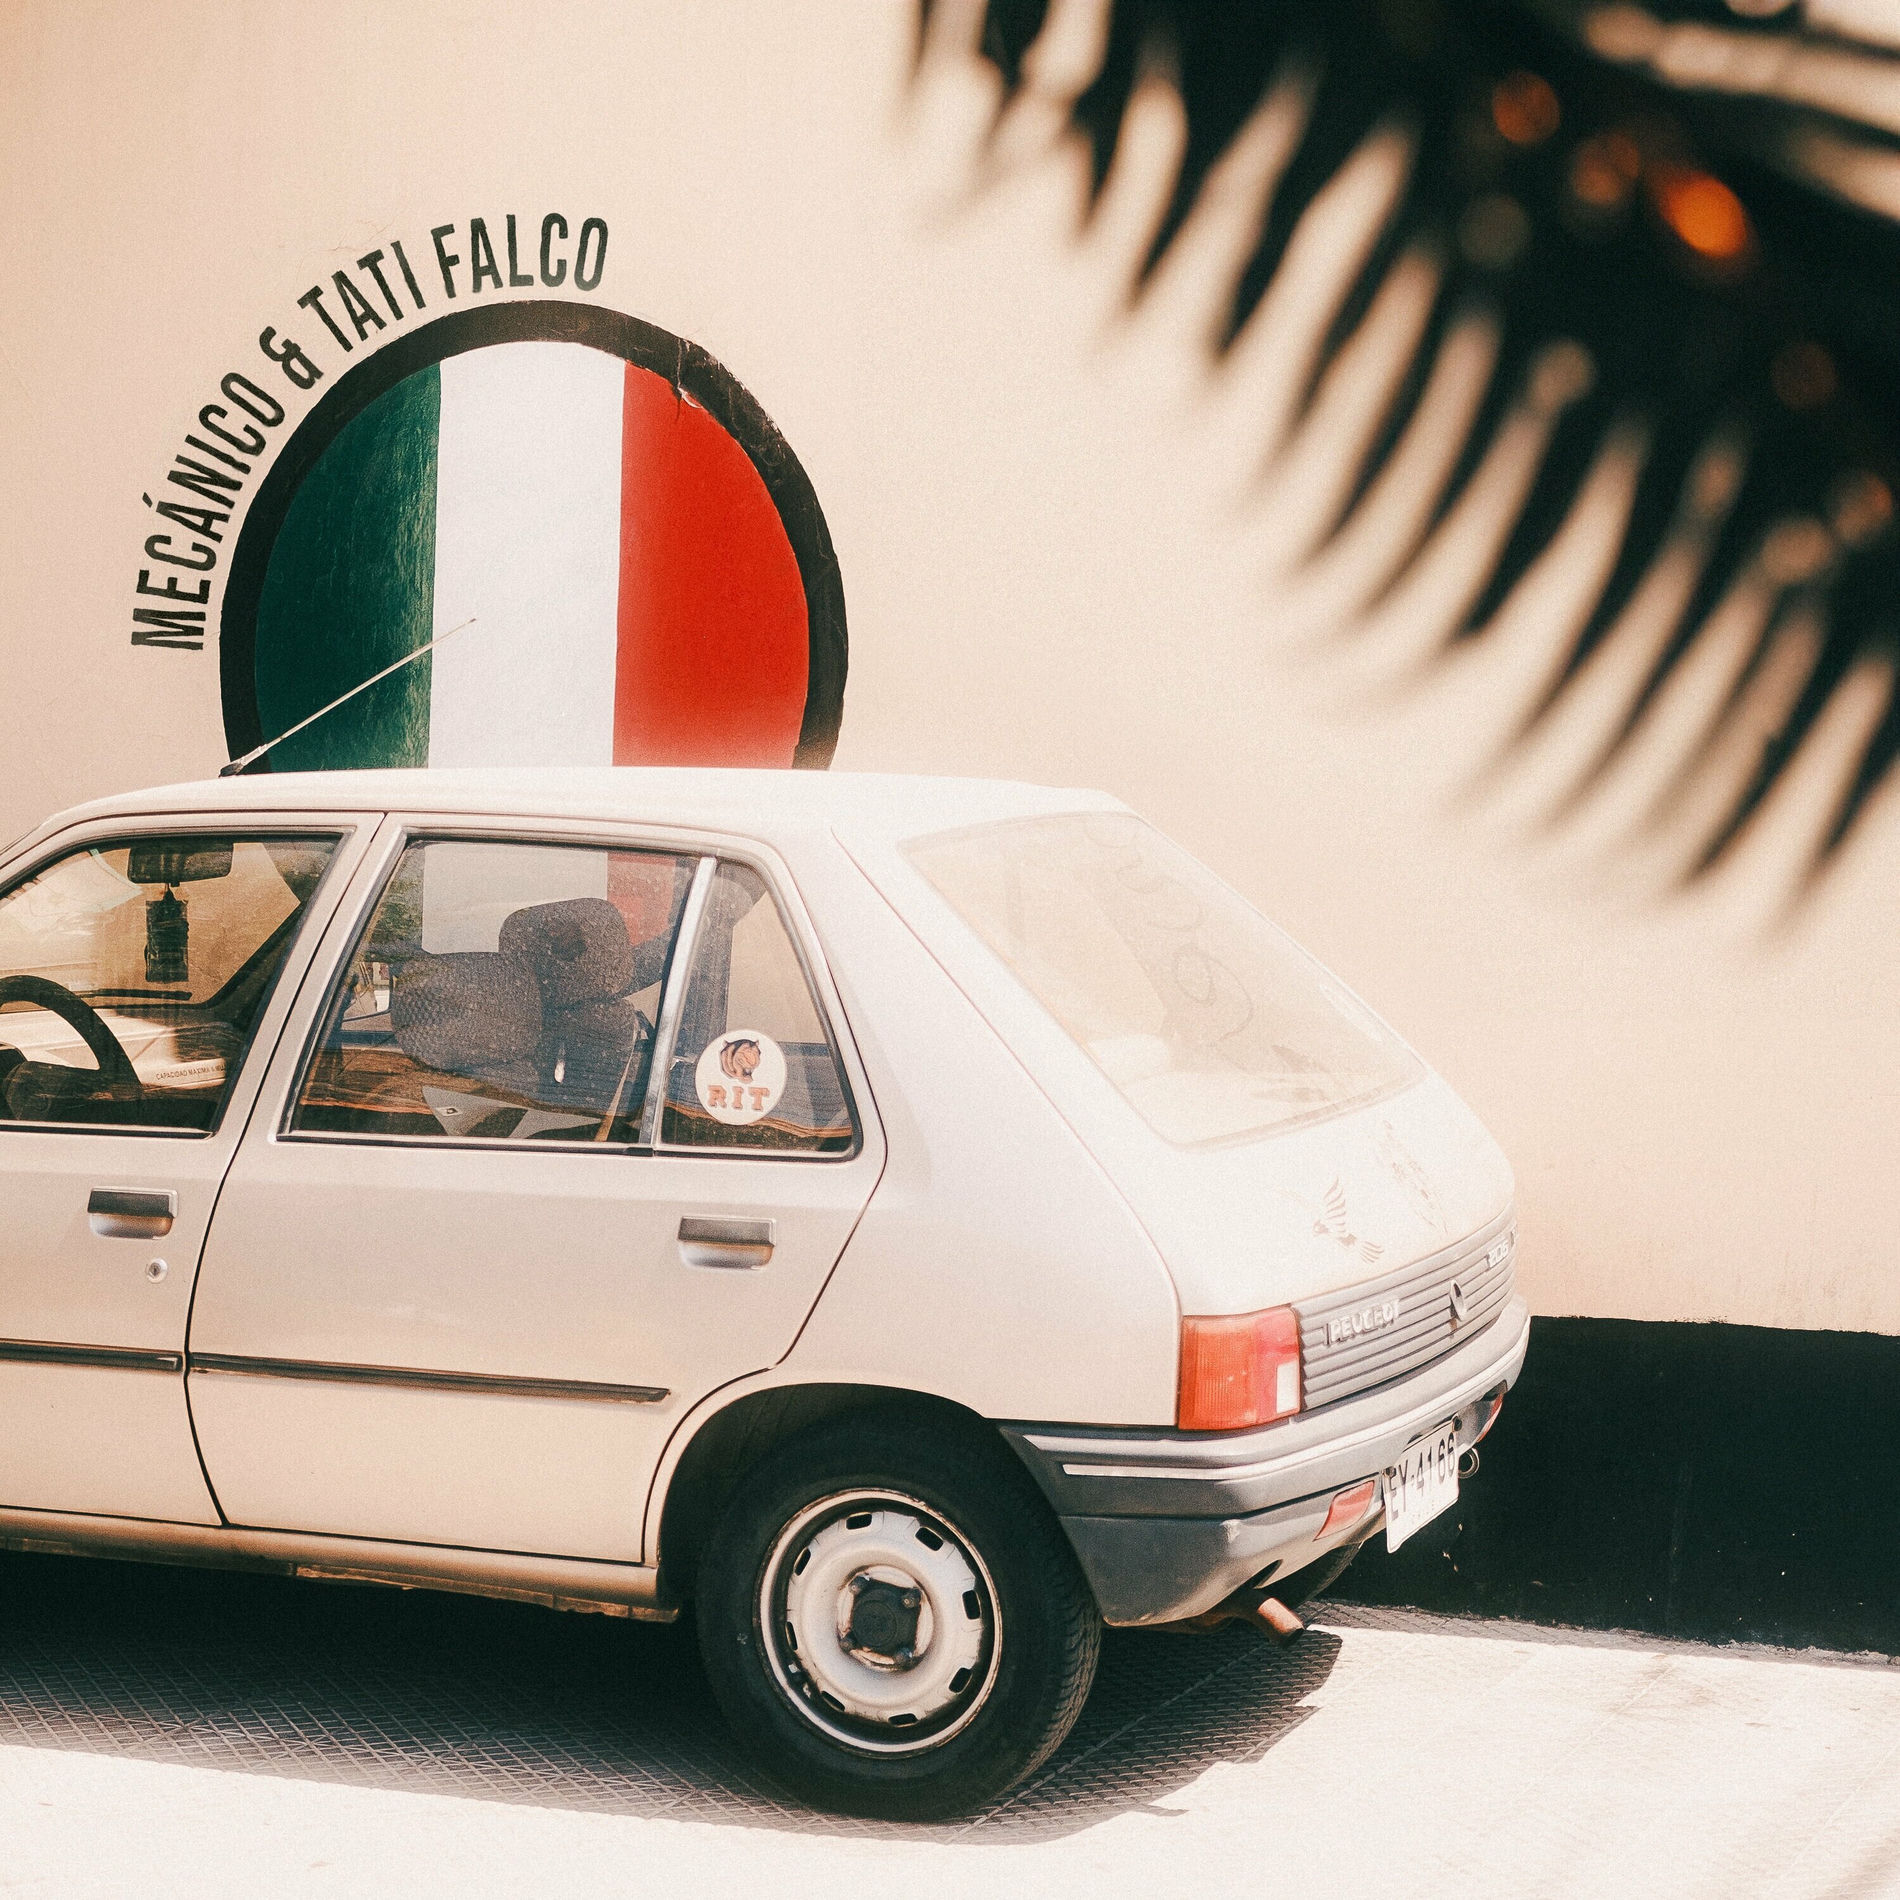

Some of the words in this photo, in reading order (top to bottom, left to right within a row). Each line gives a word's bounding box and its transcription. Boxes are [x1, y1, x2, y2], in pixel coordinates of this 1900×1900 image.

[131, 372, 285, 650] MECÁNICO
[259, 326, 324, 390] &
[297, 240, 427, 352] TATI
[430, 213, 609, 299] FALCO
[707, 1085, 770, 1111] RIT
[1329, 1298, 1400, 1342] PEUGEOT
